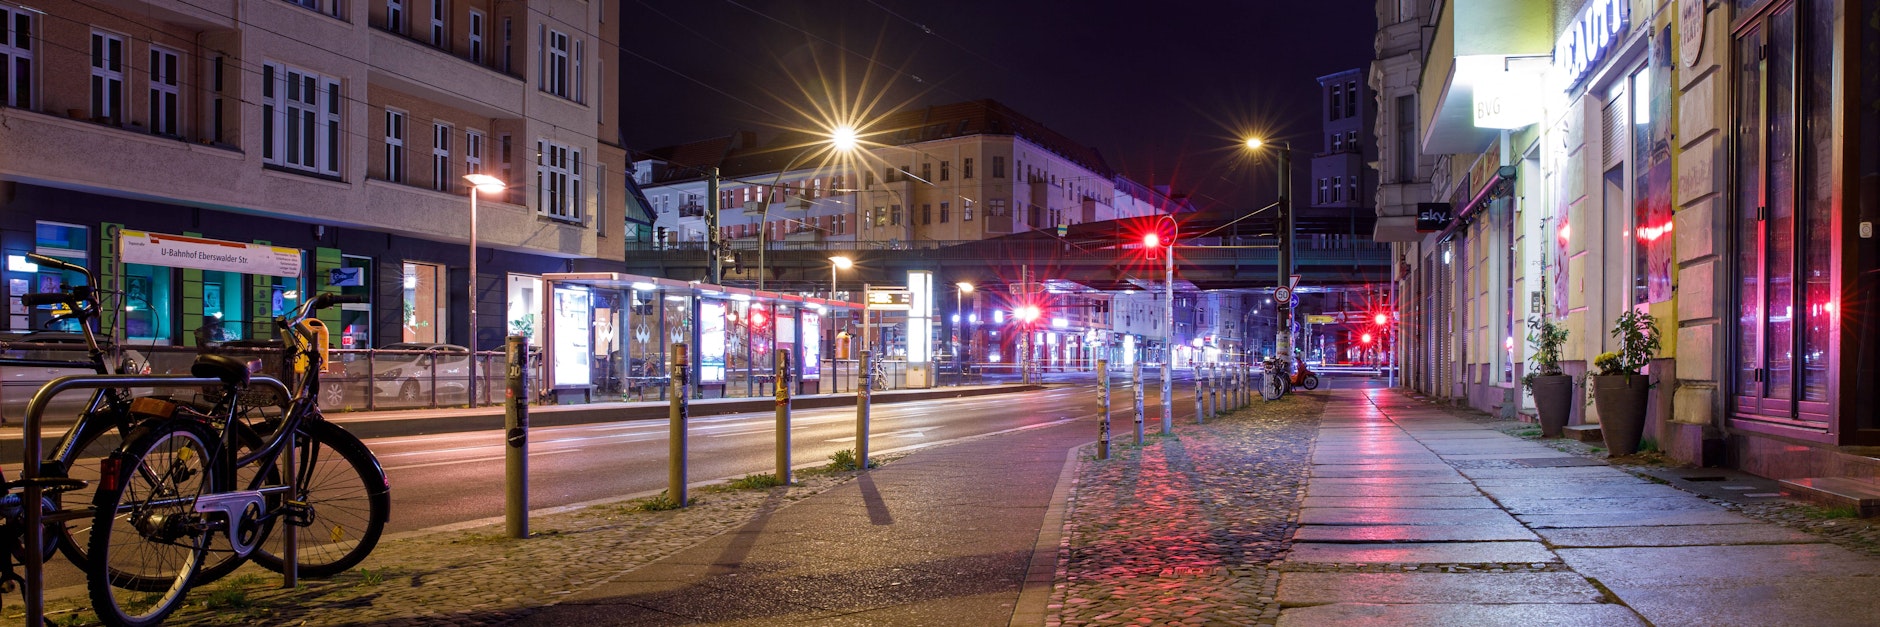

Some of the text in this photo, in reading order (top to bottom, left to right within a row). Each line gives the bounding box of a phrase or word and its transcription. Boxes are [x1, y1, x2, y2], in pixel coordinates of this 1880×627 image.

[1477, 97, 1500, 119] BVG
[1421, 209, 1446, 224] sky
[161, 248, 248, 264] U-Bahnhof Eberswalder Str.
[1278, 291, 1288, 299] 50
